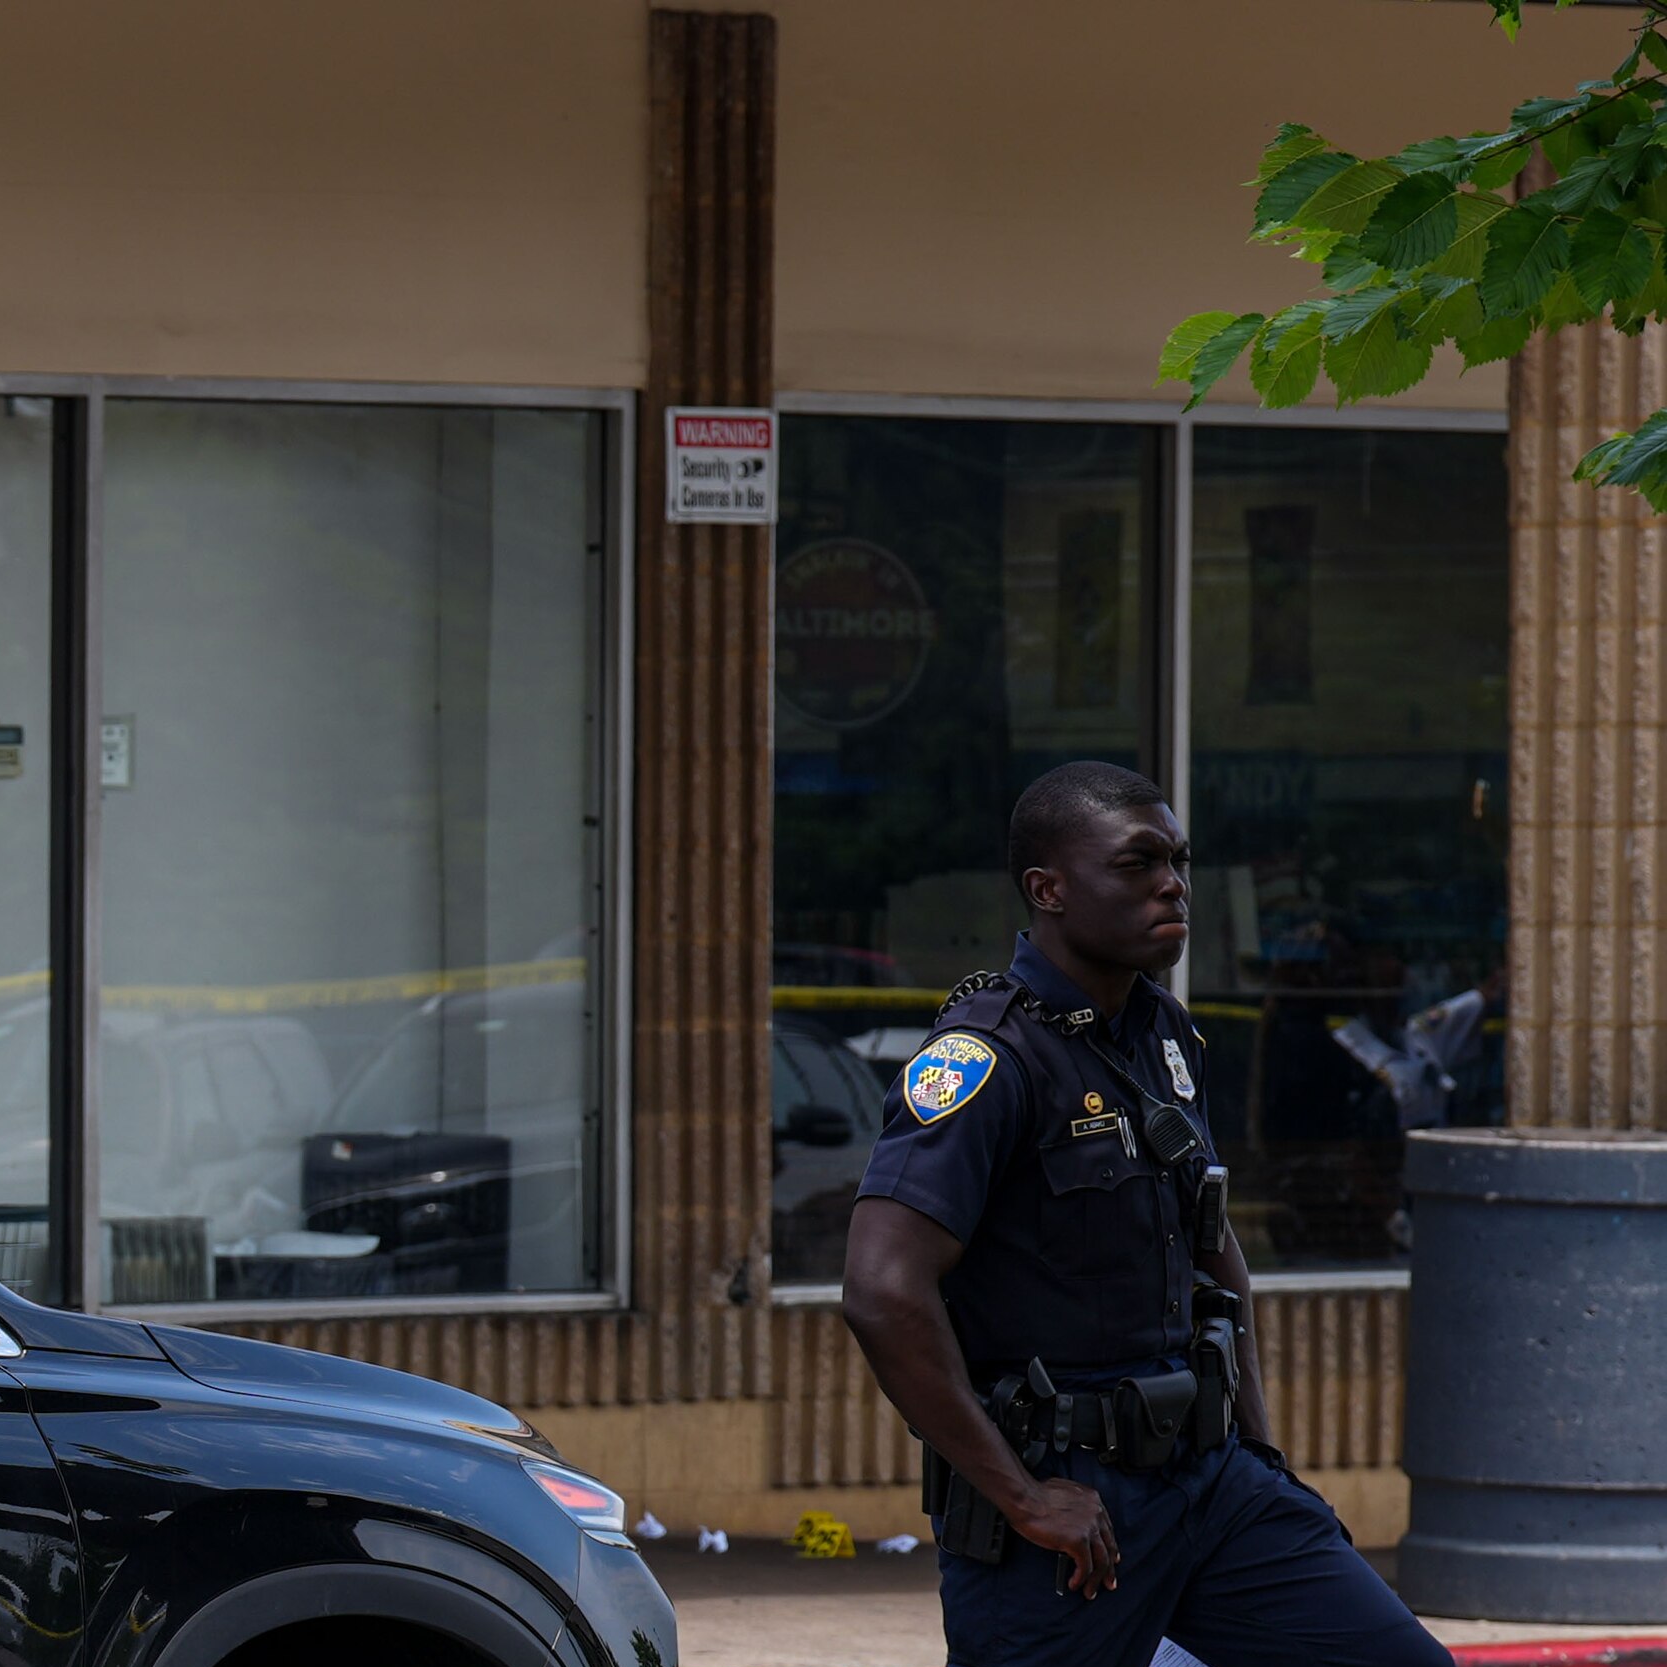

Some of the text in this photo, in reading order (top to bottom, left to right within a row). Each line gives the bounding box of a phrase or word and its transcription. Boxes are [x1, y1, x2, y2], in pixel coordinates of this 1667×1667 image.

[679, 420, 768, 445] WARNING
[682, 456, 730, 483] Security
[682, 485, 765, 508] Cameras In Use
[776, 608, 936, 638] ALTIMORE
[931, 1048, 973, 1066] POLICE
